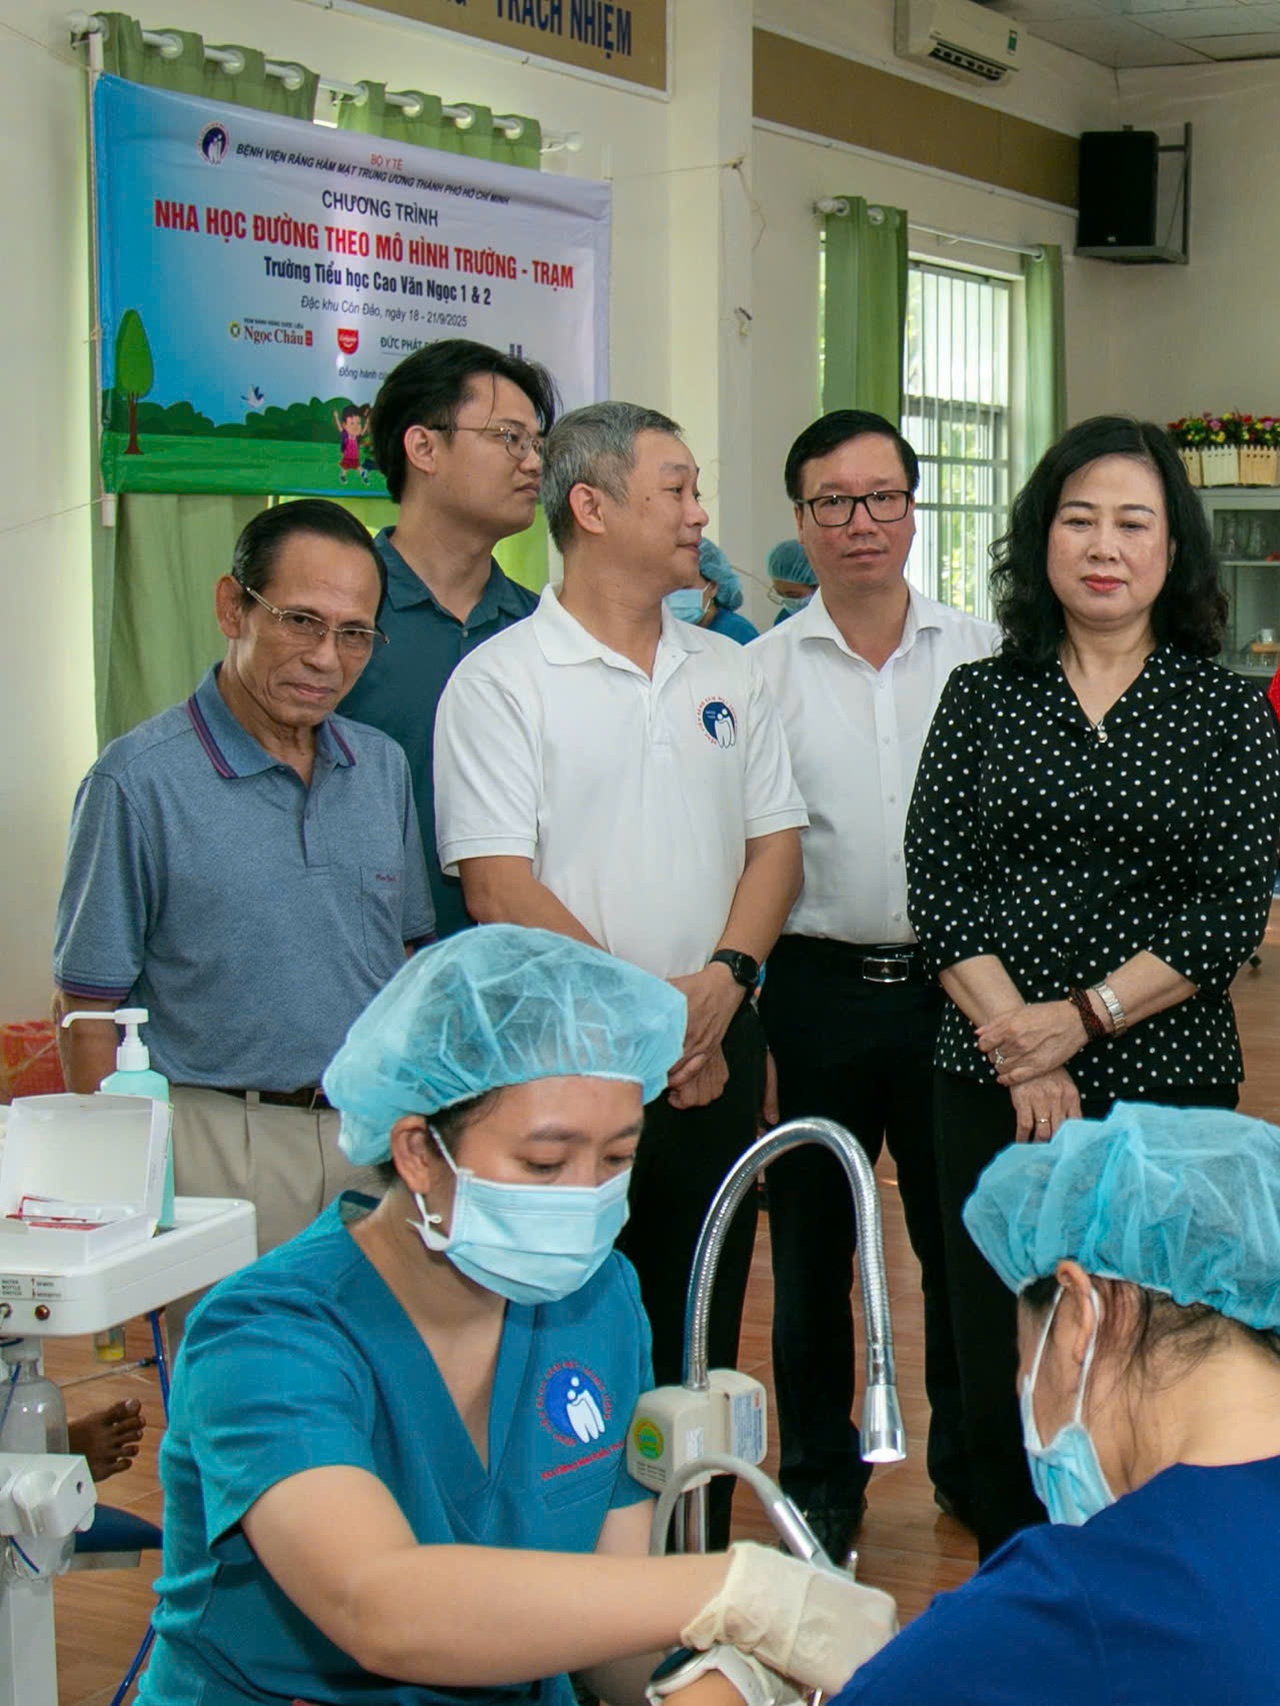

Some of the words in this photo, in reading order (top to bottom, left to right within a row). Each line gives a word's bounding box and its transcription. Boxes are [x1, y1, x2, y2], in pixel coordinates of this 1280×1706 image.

[236, 143, 264, 158] BỆNH
[265, 149, 286, 164] VIỆN
[288, 153, 314, 168] RĂNG
[316, 159, 336, 171] HÀM
[337, 163, 356, 178] MẶT
[357, 168, 387, 181] TRUNG
[388, 173, 415, 187] ƯƠNG
[416, 178, 444, 193] THÀNH
[370, 153, 382, 166] BỘ
[385, 158, 391, 167] Y
[392, 157, 403, 170] TẾ
[321, 190, 391, 219] CHƯƠNG
[395, 202, 438, 227] TRÌNH
[154, 199, 199, 232] NHA
[206, 206, 247, 243] HỌC
[252, 212, 319, 250] ĐƯỜNG
[324, 226, 370, 257] THEO
[376, 232, 404, 262] MÔ
[409, 236, 449, 270] HÌNH
[454, 246, 517, 280] TRƯỜNG
[532, 260, 574, 292] TRẠM
[263, 255, 311, 284] Trường
[314, 261, 342, 285] Tiểu
[346, 269, 369, 292] học
[373, 271, 397, 293] Cao
[401, 274, 423, 296] Văn
[427, 279, 457, 304] Ngọc
[460, 285, 467, 303] 1
[471, 286, 480, 304] &
[483, 288, 492, 306] 2
[301, 295, 320, 311] Đặc
[322, 298, 338, 313] khu
[341, 300, 360, 314] Côn
[385, 306, 405, 323] ngày
[409, 309, 419, 322] 18
[427, 311, 468, 328] 21/9/2025
[244, 325, 273, 345] Ngọc
[274, 328, 304, 345] Châu
[380, 335, 399, 349] ĐỨC
